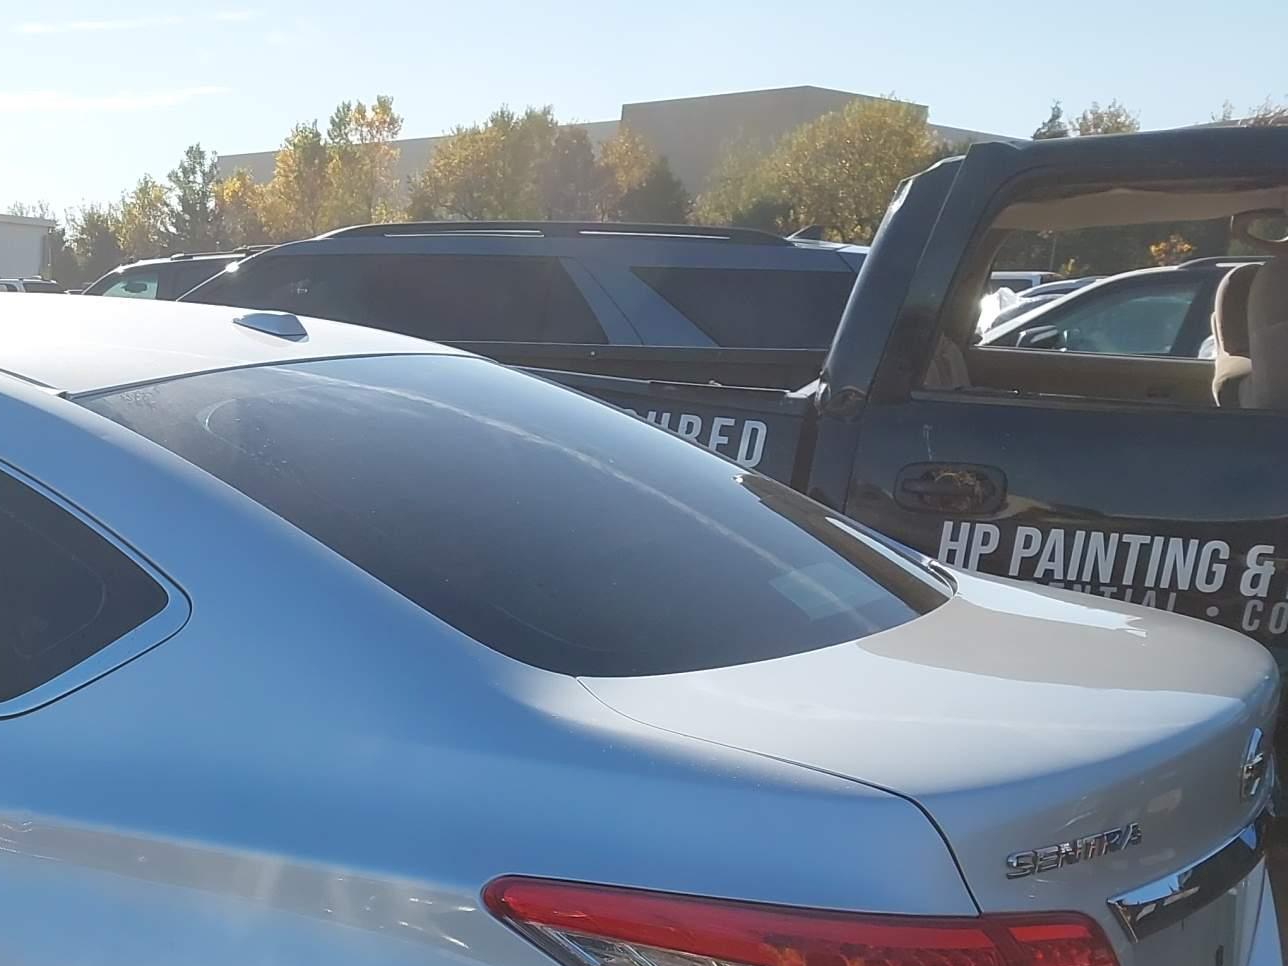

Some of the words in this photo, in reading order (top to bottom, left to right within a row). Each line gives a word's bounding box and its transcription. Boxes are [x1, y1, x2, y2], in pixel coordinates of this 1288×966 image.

[938, 521, 1000, 571] HP
[1009, 527, 1231, 593] PAINTING
[1240, 545, 1276, 597] &
[1005, 822, 1143, 880] SENTRA
